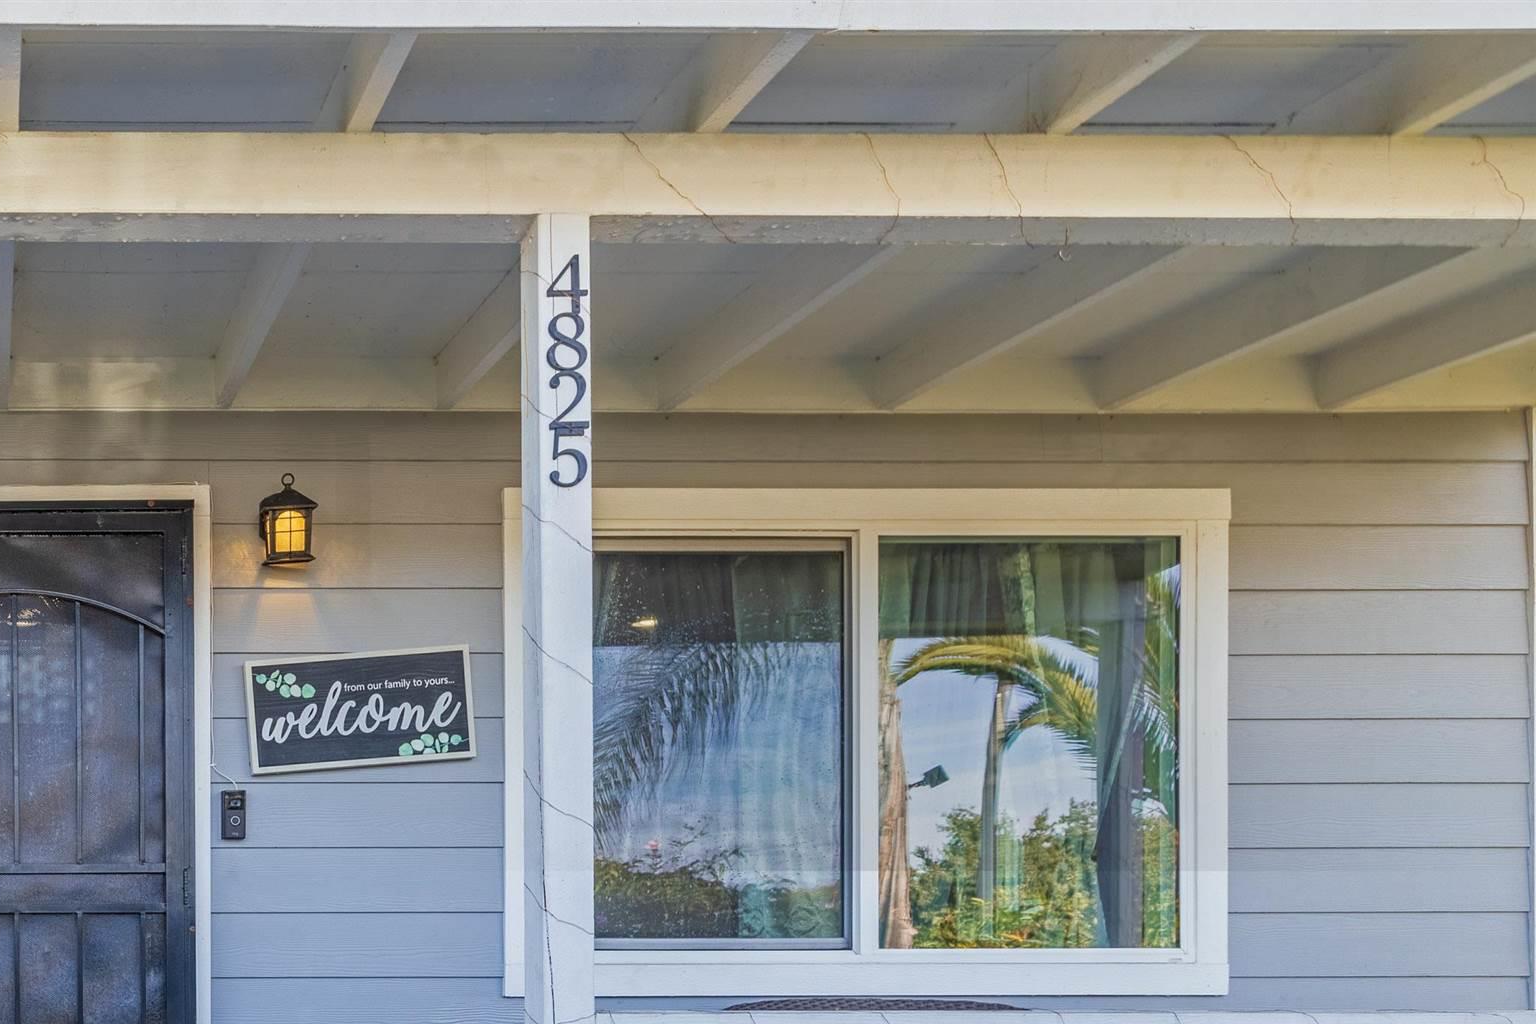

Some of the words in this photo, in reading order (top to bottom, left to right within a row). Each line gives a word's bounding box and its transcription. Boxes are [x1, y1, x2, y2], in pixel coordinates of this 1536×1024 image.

[546, 253, 590, 488] 4825
[261, 680, 462, 744] welcome
[344, 682, 365, 693] from
[367, 682, 382, 691] our
[384, 678, 411, 690] family
[413, 678, 422, 687] to
[424, 677, 455, 688] yours...
